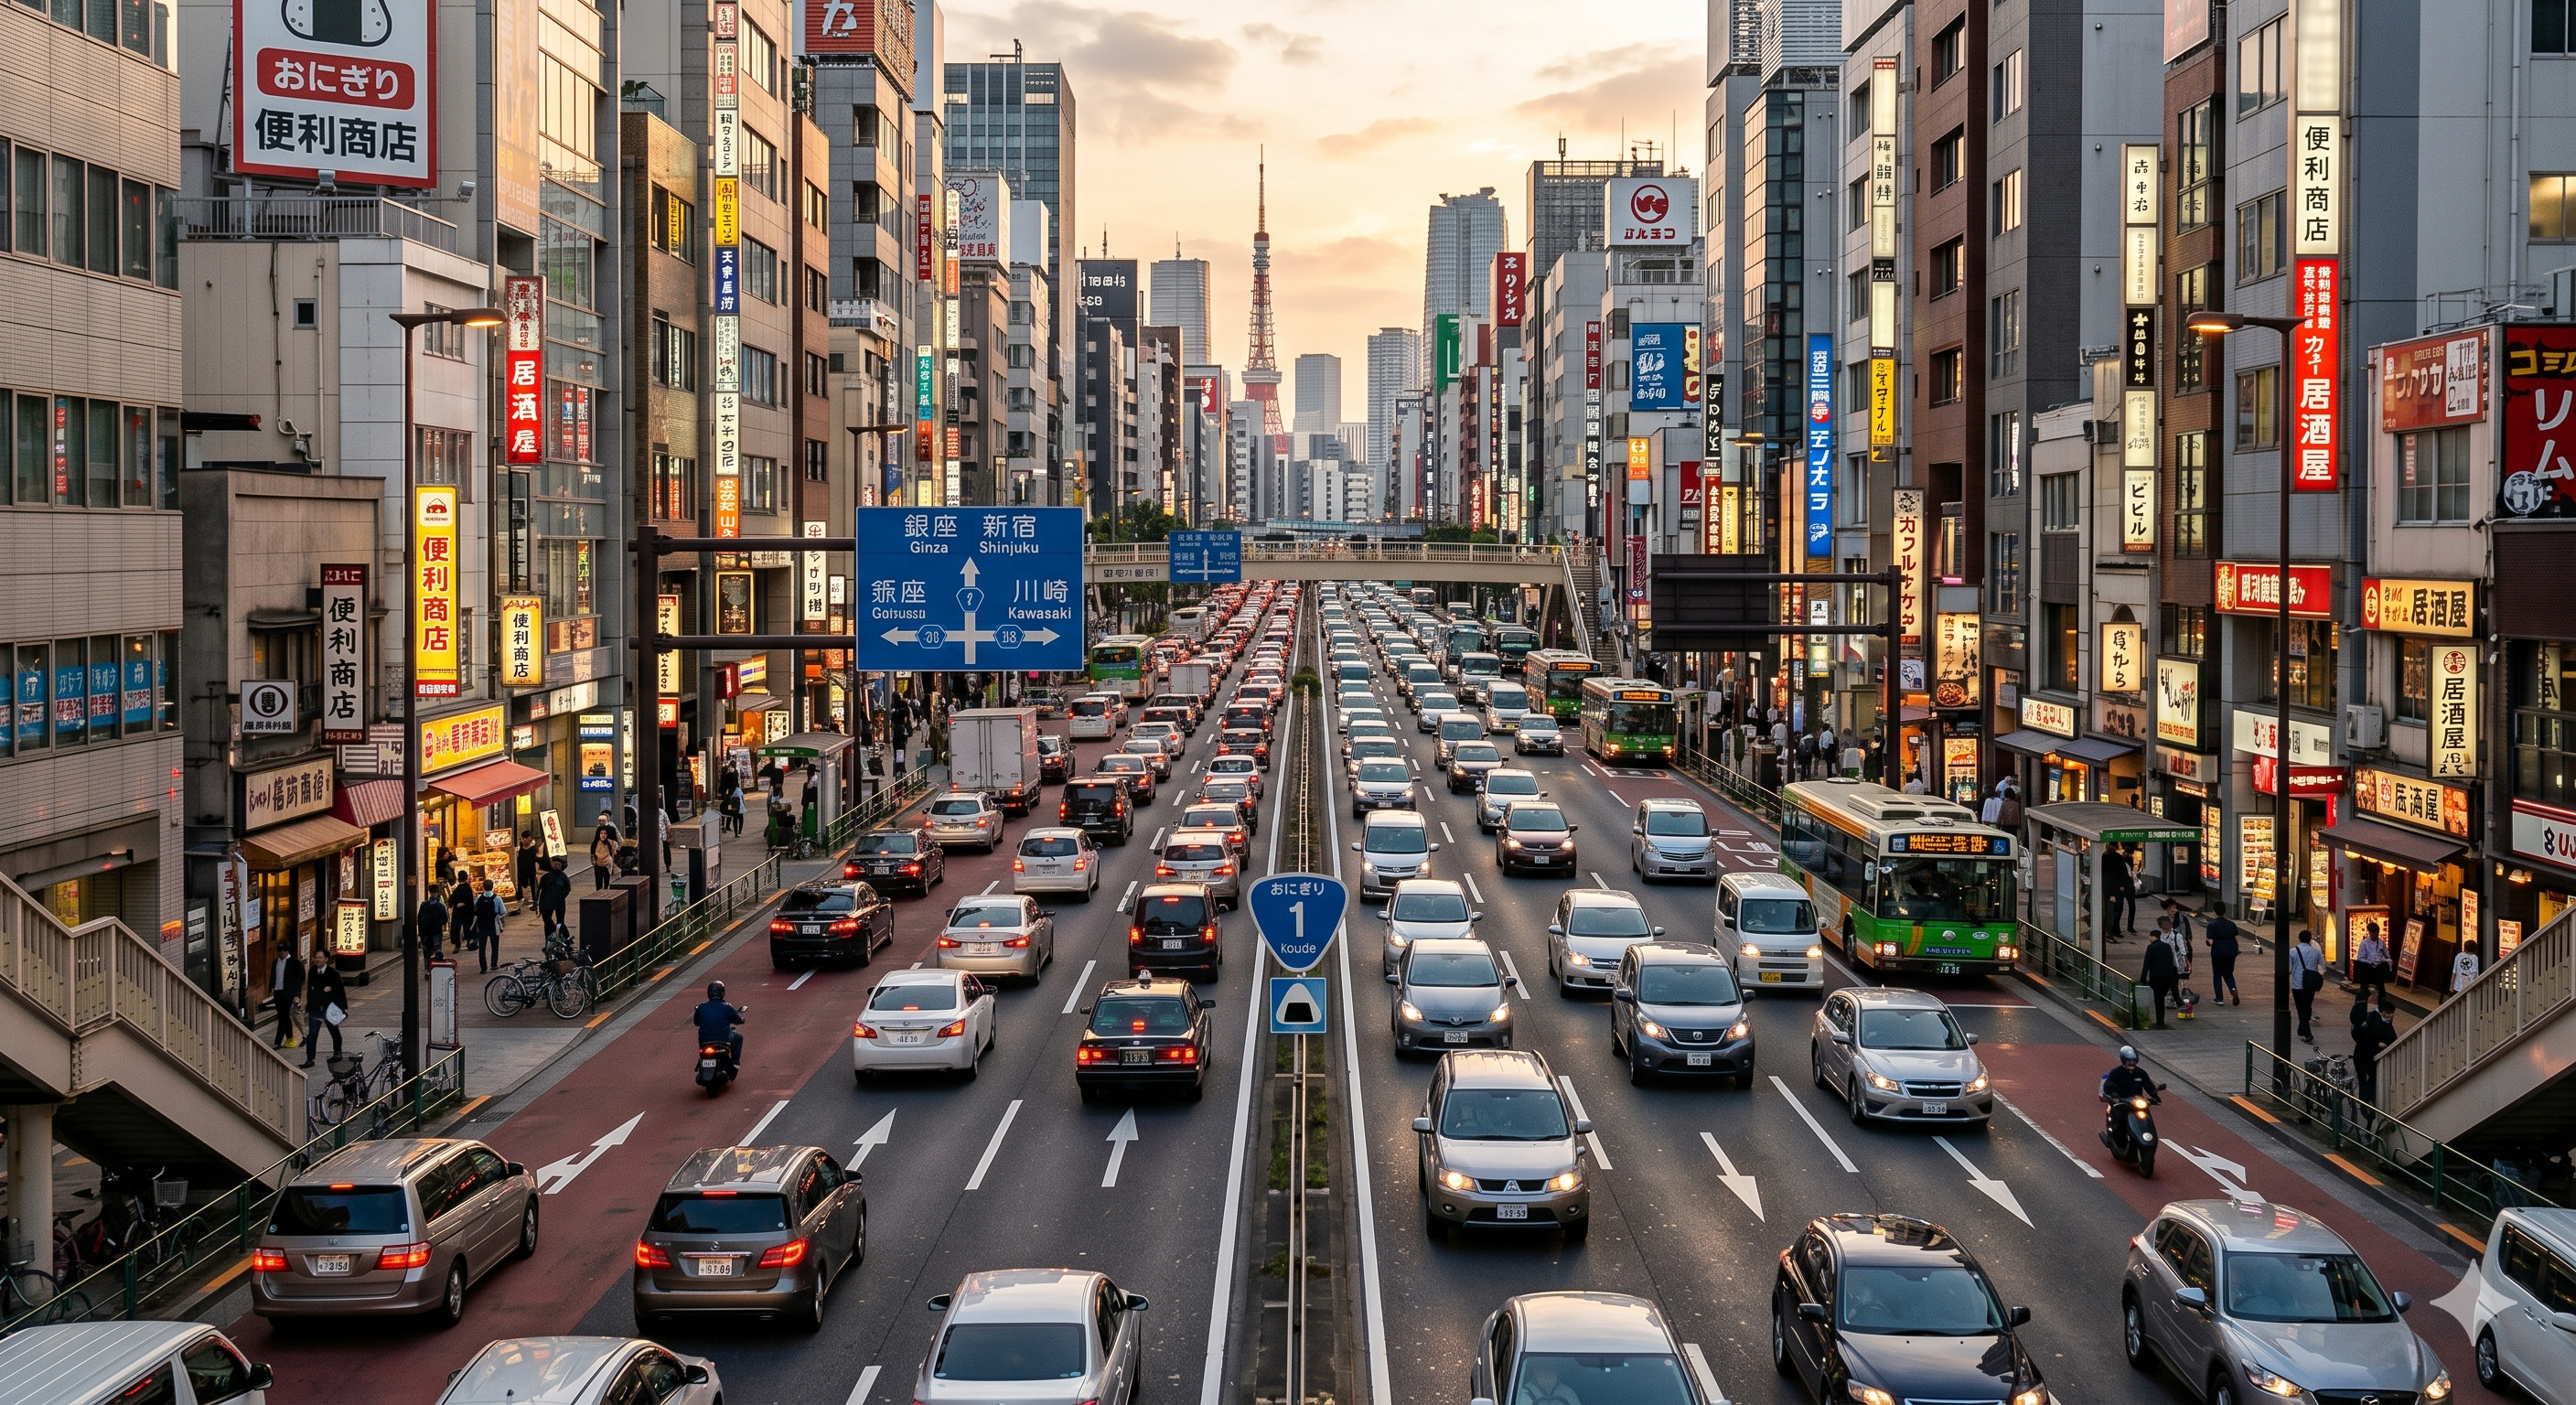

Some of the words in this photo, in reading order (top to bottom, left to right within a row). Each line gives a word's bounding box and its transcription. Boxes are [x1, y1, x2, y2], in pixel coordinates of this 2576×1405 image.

[274, 56, 400, 101] おにぎり
[254, 107, 418, 164] 便利商店
[2303, 124, 2331, 241] 便利商店
[511, 359, 538, 454] 居酒屋
[2299, 378, 2333, 481] 居酒屋
[904, 513, 958, 539] 銀座
[982, 513, 1036, 538] 新宿
[909, 541, 949, 554] Ginza
[979, 541, 1039, 556] Shinjuku
[422, 535, 450, 652] 便利商店
[1008, 606, 1072, 619] Kawasaki
[1013, 578, 1069, 604] 川崎
[327, 595, 359, 720] 便利商店
[2441, 677, 2466, 749] 居酒屋
[1271, 882, 1325, 896] おにぎり
[1288, 901, 1304, 938] 1
[1281, 942, 1316, 954] Koude
